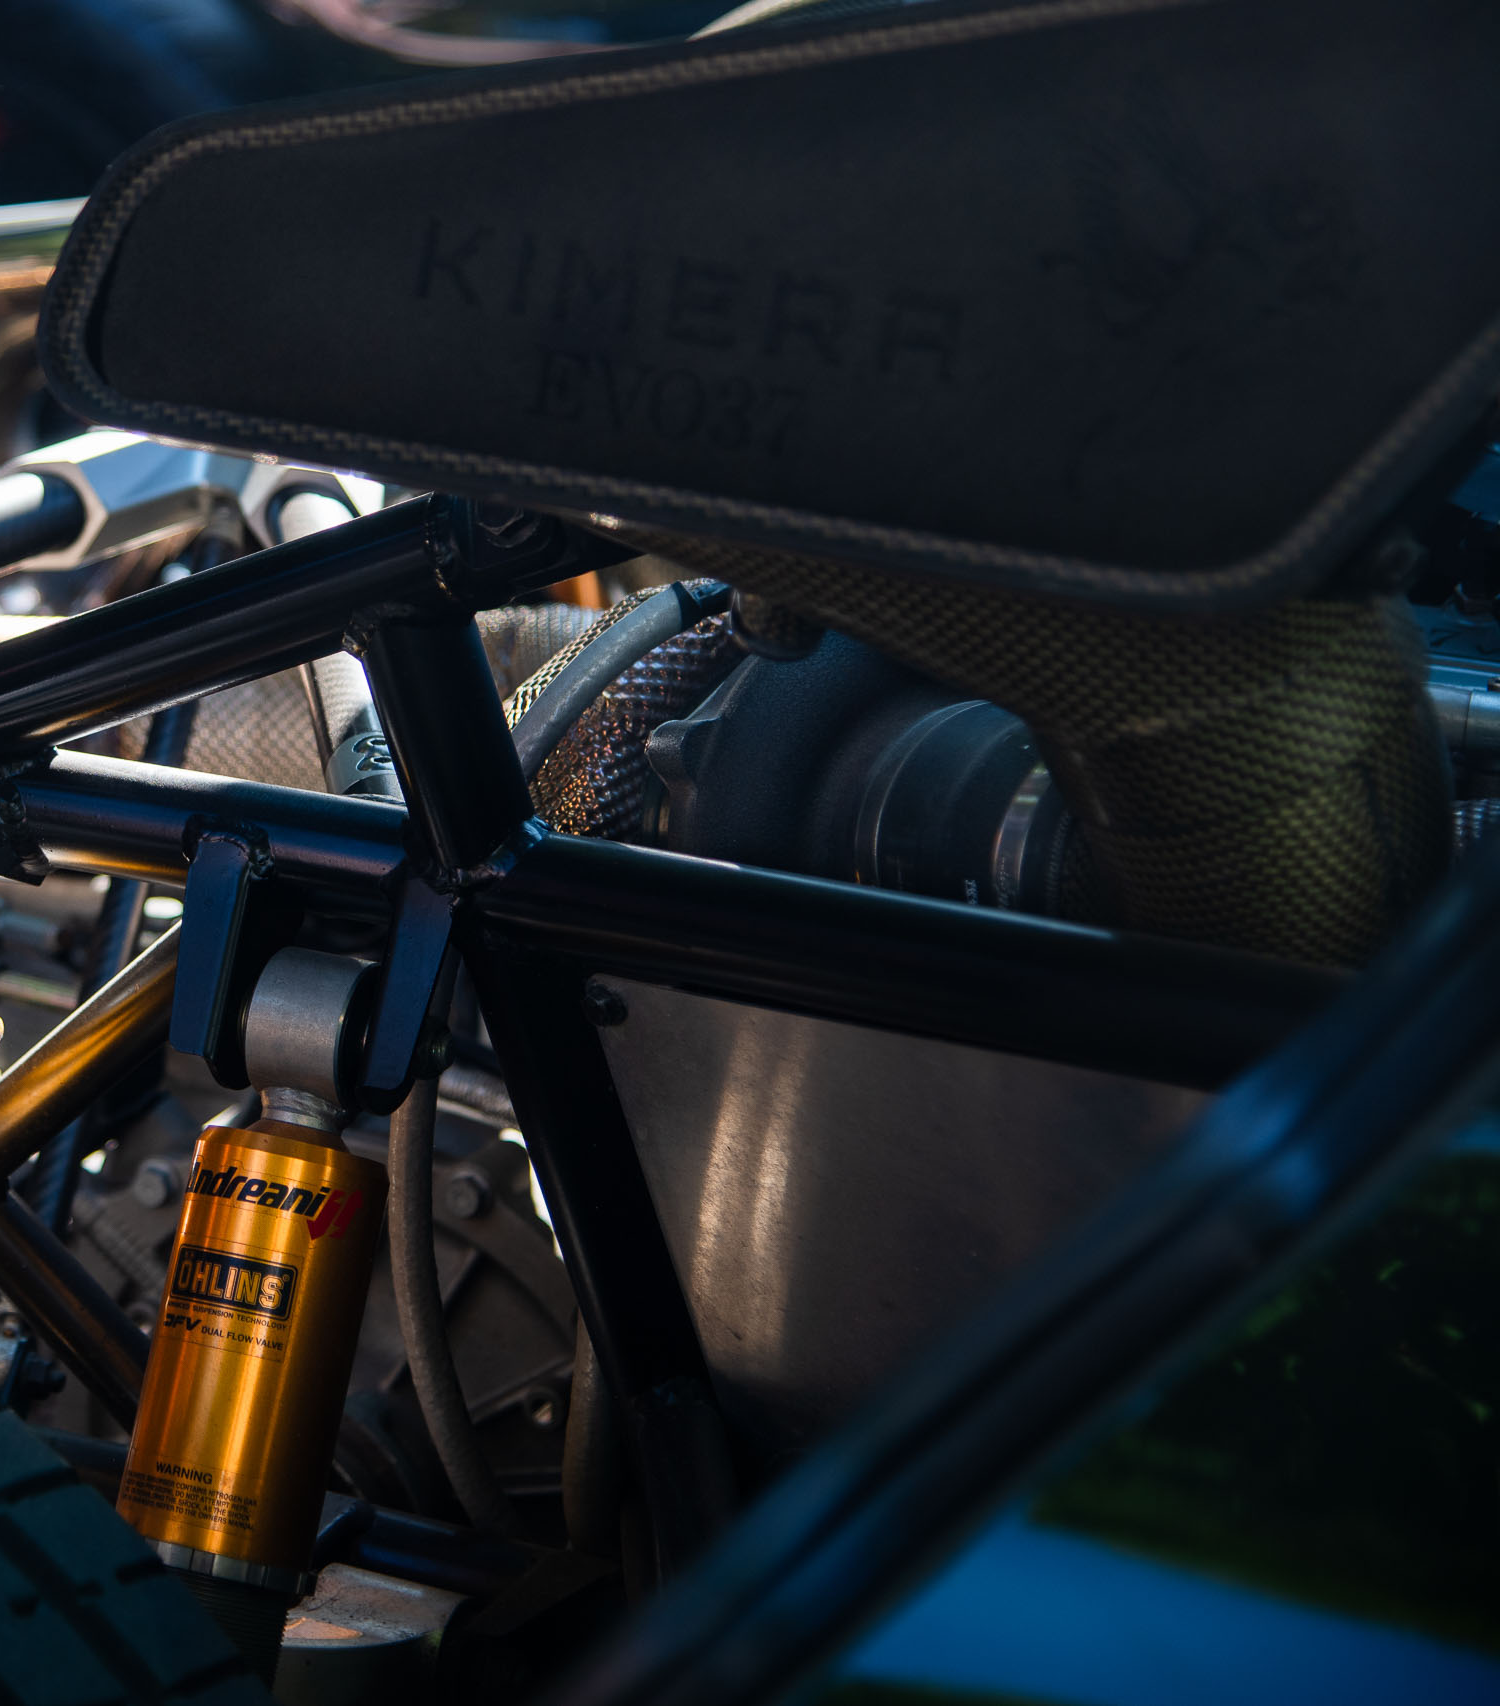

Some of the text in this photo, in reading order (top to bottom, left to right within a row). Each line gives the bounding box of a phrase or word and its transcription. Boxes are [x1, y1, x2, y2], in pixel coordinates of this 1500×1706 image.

[414, 213, 964, 384] KIMERA
[523, 342, 806, 459] EVO37
[193, 1306, 286, 1330] SUSPENSION TECHNOLOGY
[201, 1327, 224, 1337] DUAL
[227, 1333, 253, 1343] FLOW
[255, 1339, 283, 1350] VALVE
[156, 1461, 213, 1485] WARNING
[175, 1490, 184, 1498] DO
[186, 1493, 200, 1502] NOT
[200, 1497, 229, 1508] ATTEMPT
[208, 1490, 242, 1503] NITROGEN
[175, 1506, 184, 1515] TO
[198, 1512, 227, 1524] OWNERS
[213, 1507, 227, 1516] THE
